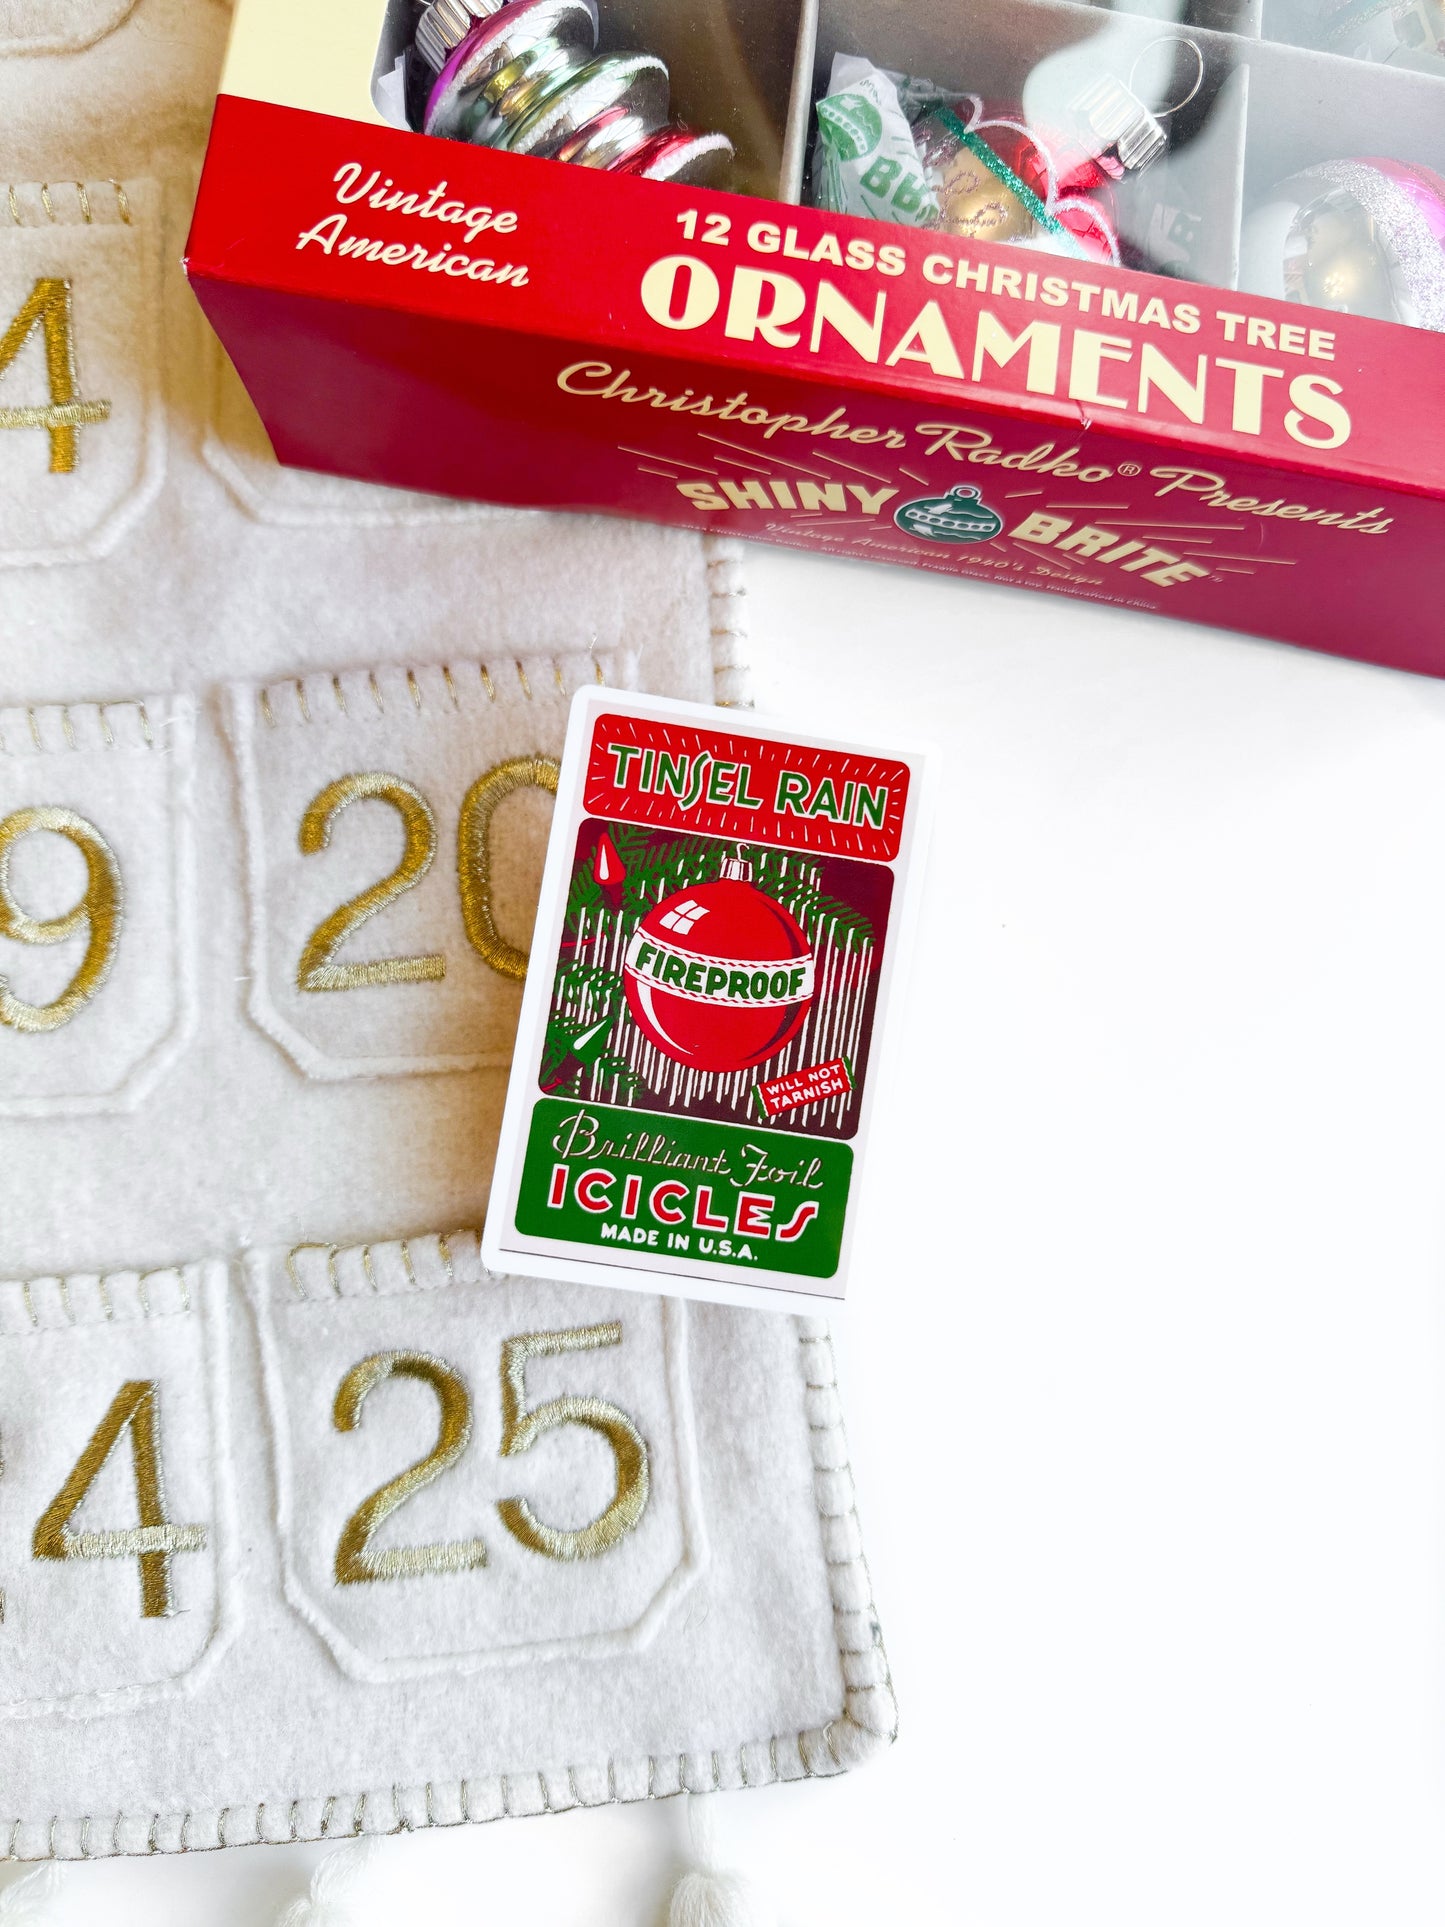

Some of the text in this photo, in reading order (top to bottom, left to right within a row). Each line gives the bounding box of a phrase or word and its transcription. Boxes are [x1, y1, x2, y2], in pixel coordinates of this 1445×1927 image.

[332, 161, 519, 243] Vintage
[295, 213, 530, 288] American
[675, 208, 1337, 361] 12 GLASS CHRISTMAS TREE
[640, 254, 1352, 450] ORNAMENTS
[556, 361, 906, 449] Christopher
[1149, 465, 1396, 536] Presents
[676, 480, 900, 516] SHINY
[765, 522, 845, 543] Vintage
[852, 537, 950, 559] American
[607, 742, 889, 832] TINSEL RAIN
[634, 940, 807, 1000] FIREPROOF
[765, 1063, 840, 1096] WILL NOT
[769, 1077, 844, 1110] TARNISH
[551, 1107, 825, 1189] Brilliant Foil
[546, 1162, 821, 1243] ICICLES
[600, 1221, 760, 1262] MADE IN U.S.A.
[332, 1320, 652, 1586] 25
